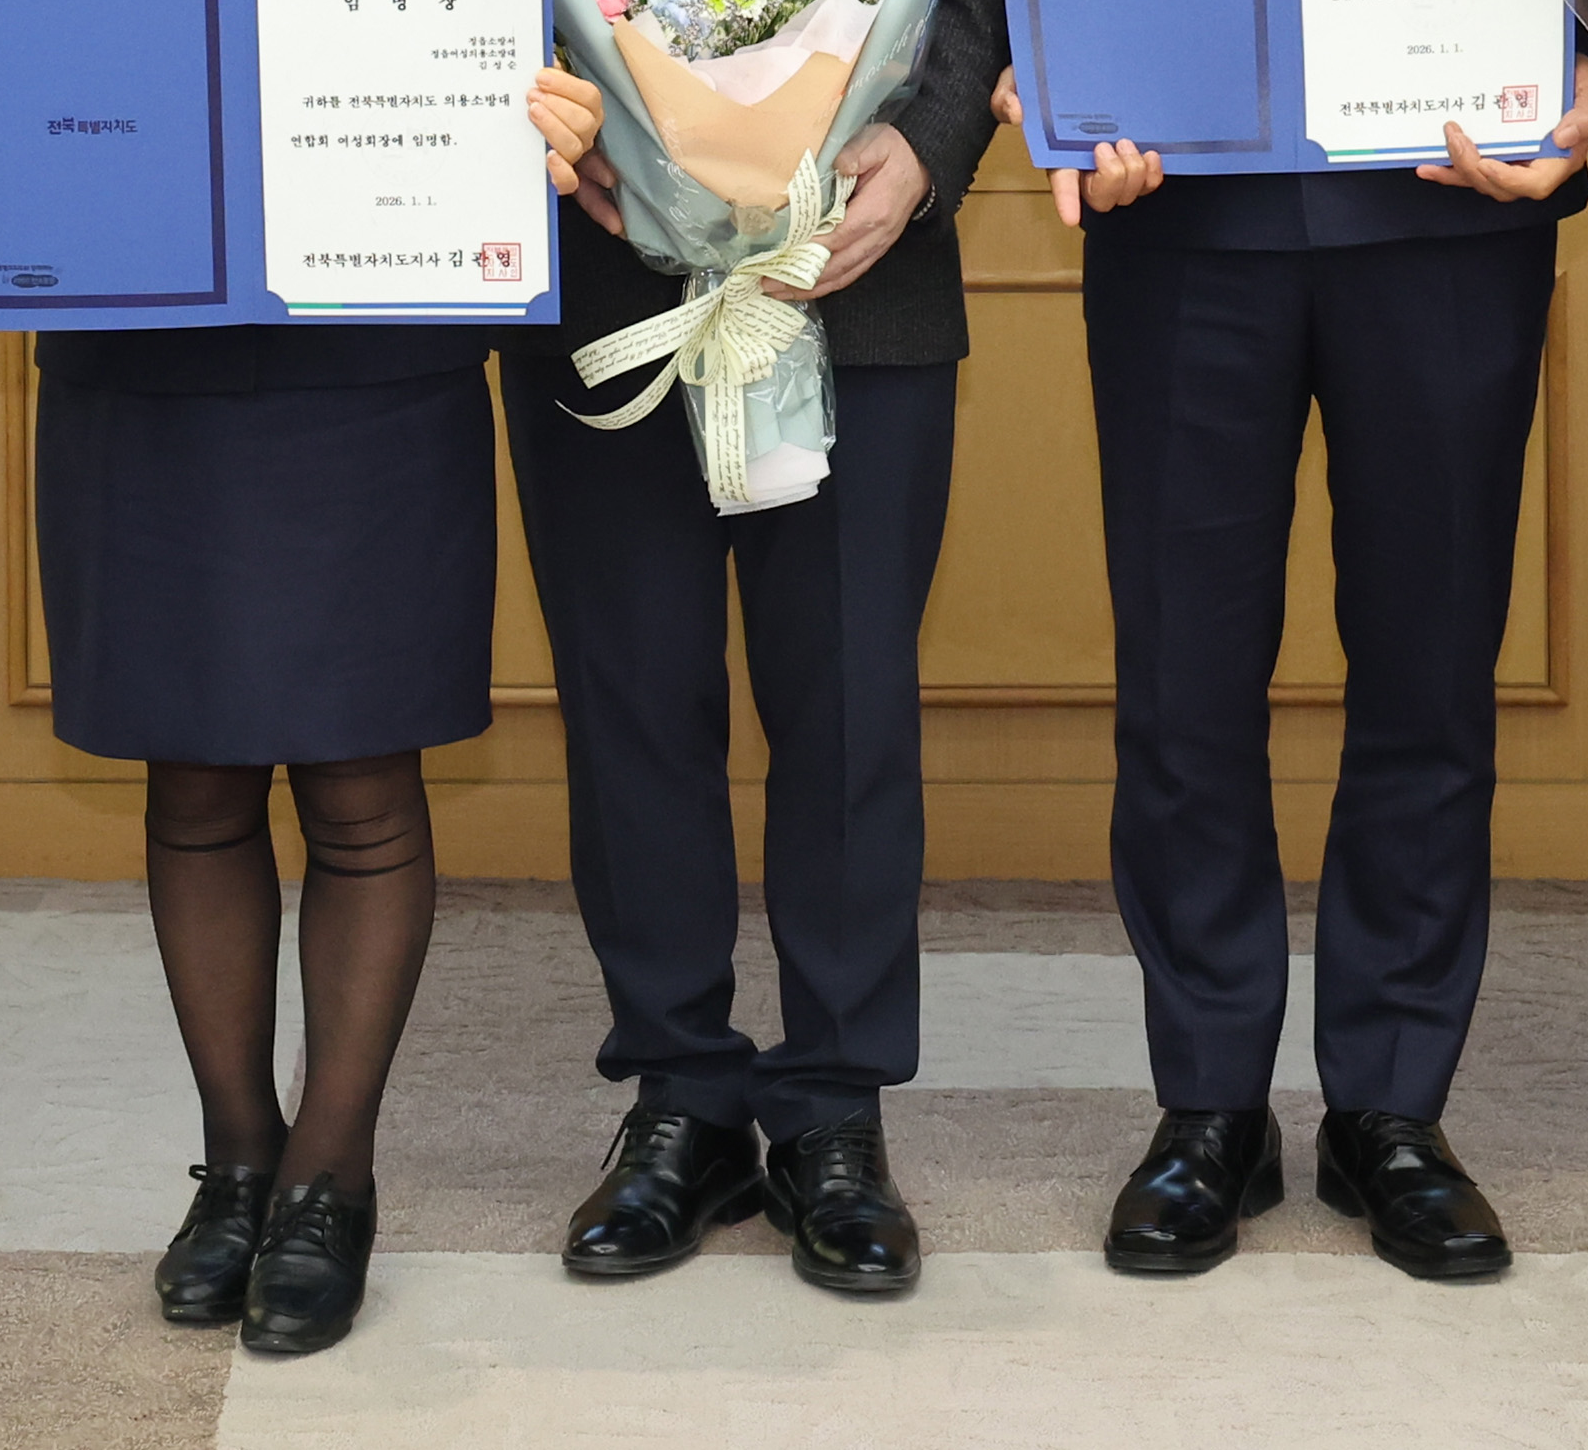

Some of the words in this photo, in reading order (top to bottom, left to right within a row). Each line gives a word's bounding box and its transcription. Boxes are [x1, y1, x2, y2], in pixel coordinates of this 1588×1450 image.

[1407, 45, 1435, 55] 2026.
[303, 95, 341, 109] 귀하를
[349, 94, 437, 109] 전북특별자치도
[444, 93, 510, 108] 의용소방대
[290, 134, 329, 148] 연합회
[337, 133, 404, 148] 여성회장에
[412, 133, 457, 147] 임명함.
[375, 196, 406, 207] 2026.
[303, 252, 441, 268] 전북특별자치도지사
